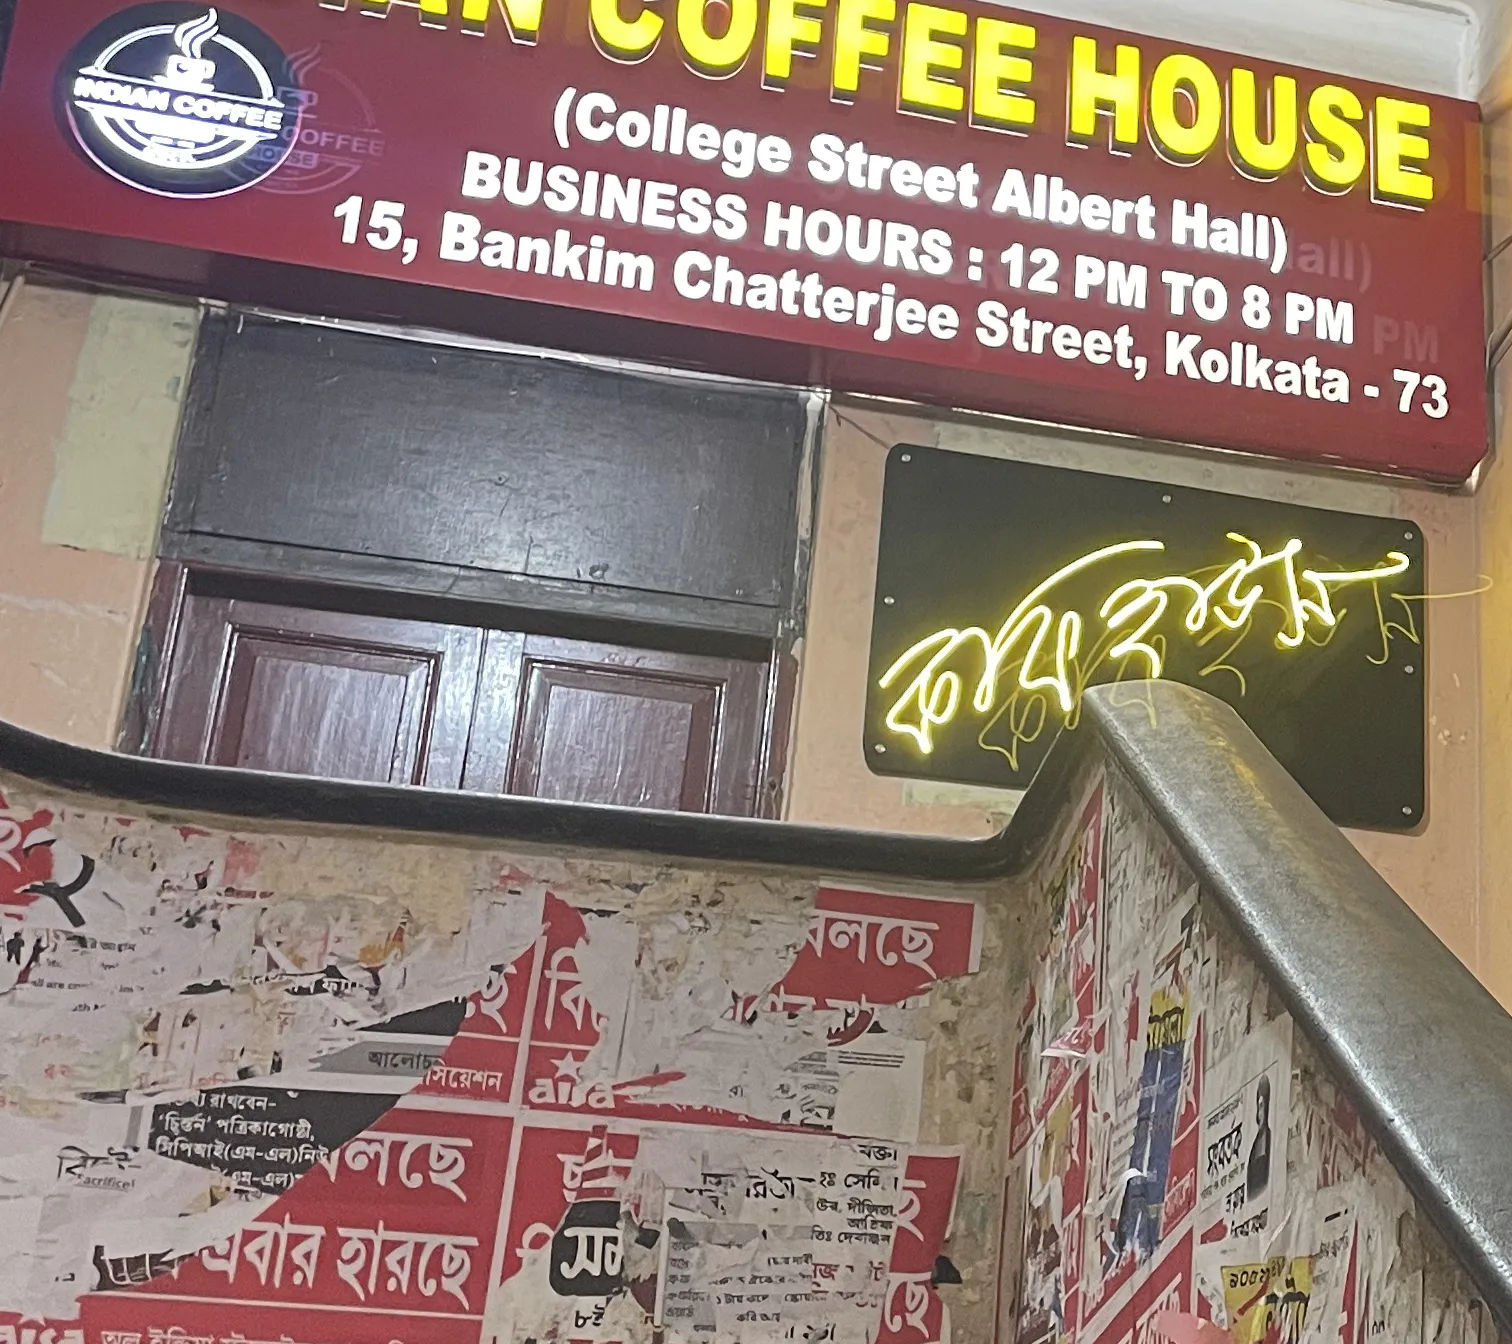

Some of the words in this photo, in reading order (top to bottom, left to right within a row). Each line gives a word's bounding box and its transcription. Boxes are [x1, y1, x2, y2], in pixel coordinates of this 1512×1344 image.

[73, 76, 169, 110] INDIAN
[172, 94, 283, 131] COFFEE
[554, 87, 792, 178] (College
[806, 132, 979, 209] Street
[991, 167, 1157, 242] Albert
[1171, 199, 1288, 274] Hall)
[1067, 36, 1435, 206] HOUSE
[333, 196, 420, 265] 15,
[439, 212, 656, 293] Bankim
[673, 250, 961, 343] Chatterjee
[974, 299, 1149, 382] Street,
[1162, 331, 1351, 406] Kolkata
[1392, 369, 1450, 421] 73
[461, 151, 748, 241] BUSINESS
[763, 202, 954, 276] HOURS
[1000, 242, 1060, 295] 12
[1073, 257, 1148, 310] PM
[1161, 271, 1229, 323] TO
[1242, 286, 1271, 331] 8
[1285, 294, 1356, 346] PM
[528, 1076, 615, 1109] aisa
[336, 1220, 480, 1312] হারছে
